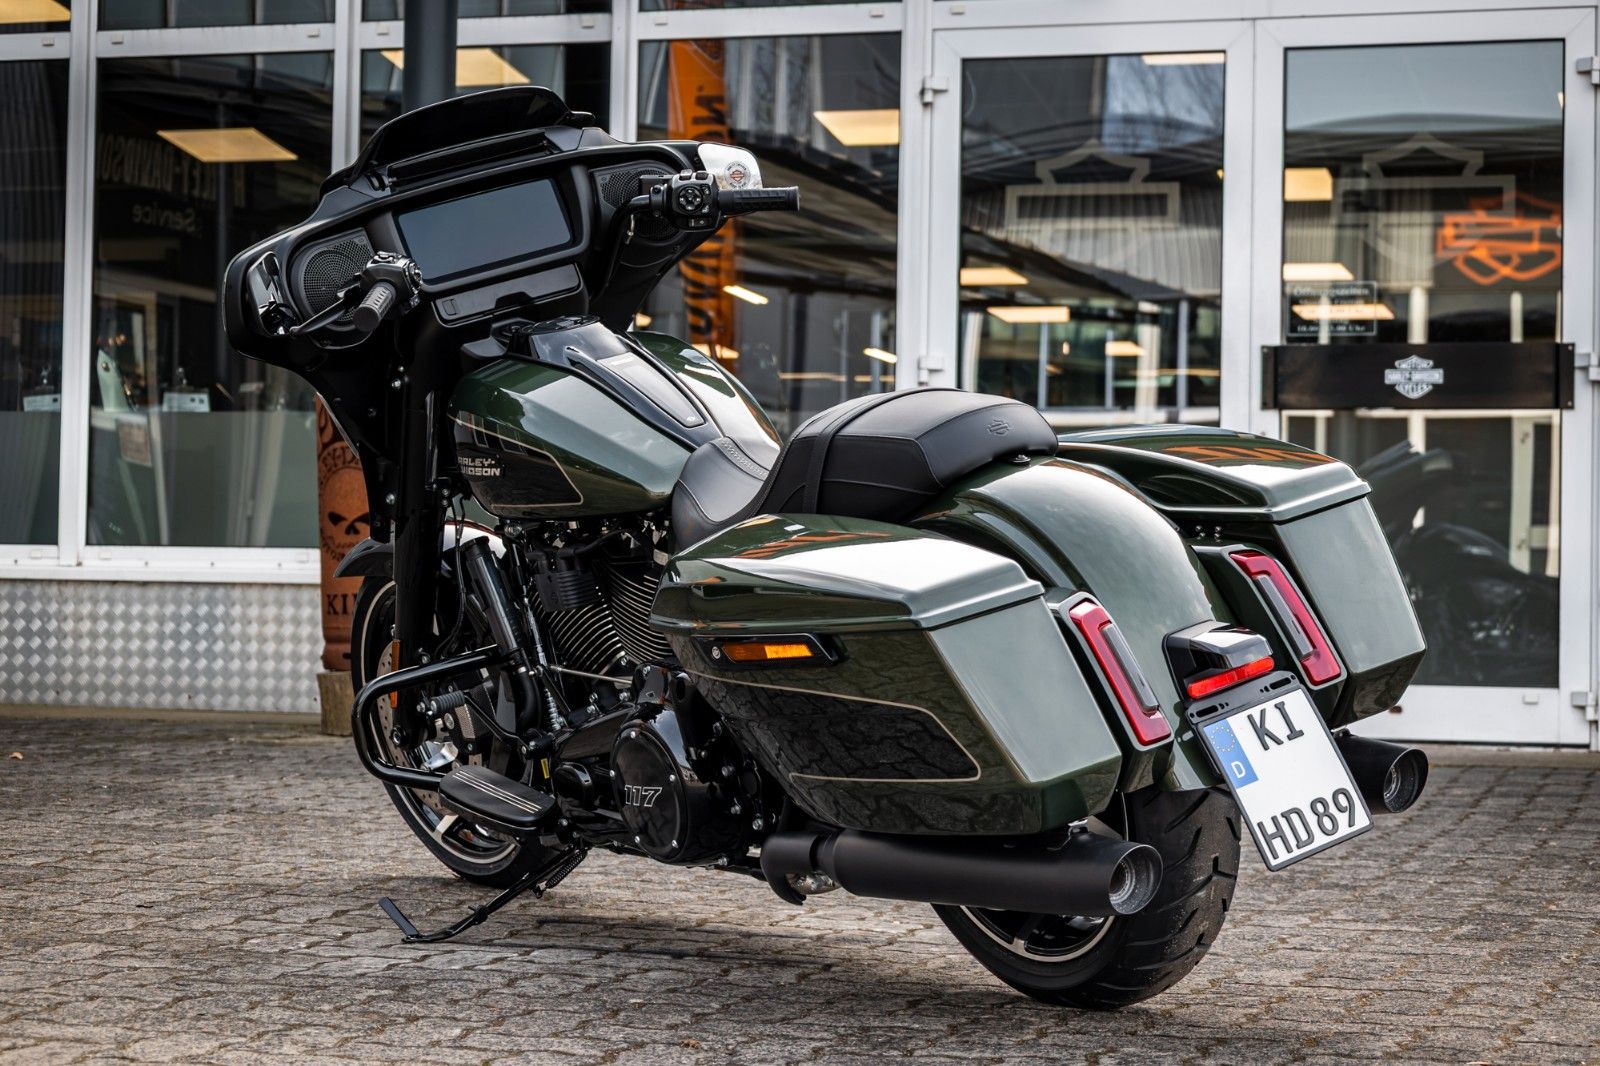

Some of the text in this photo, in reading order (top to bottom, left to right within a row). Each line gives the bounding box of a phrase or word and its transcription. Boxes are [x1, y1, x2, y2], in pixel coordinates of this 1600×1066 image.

[458, 457, 496, 467] ARLEY-
[460, 466, 501, 477] VIDSON
[1247, 701, 1305, 751] KI
[1230, 760, 1247, 779] D
[624, 784, 663, 808] 117
